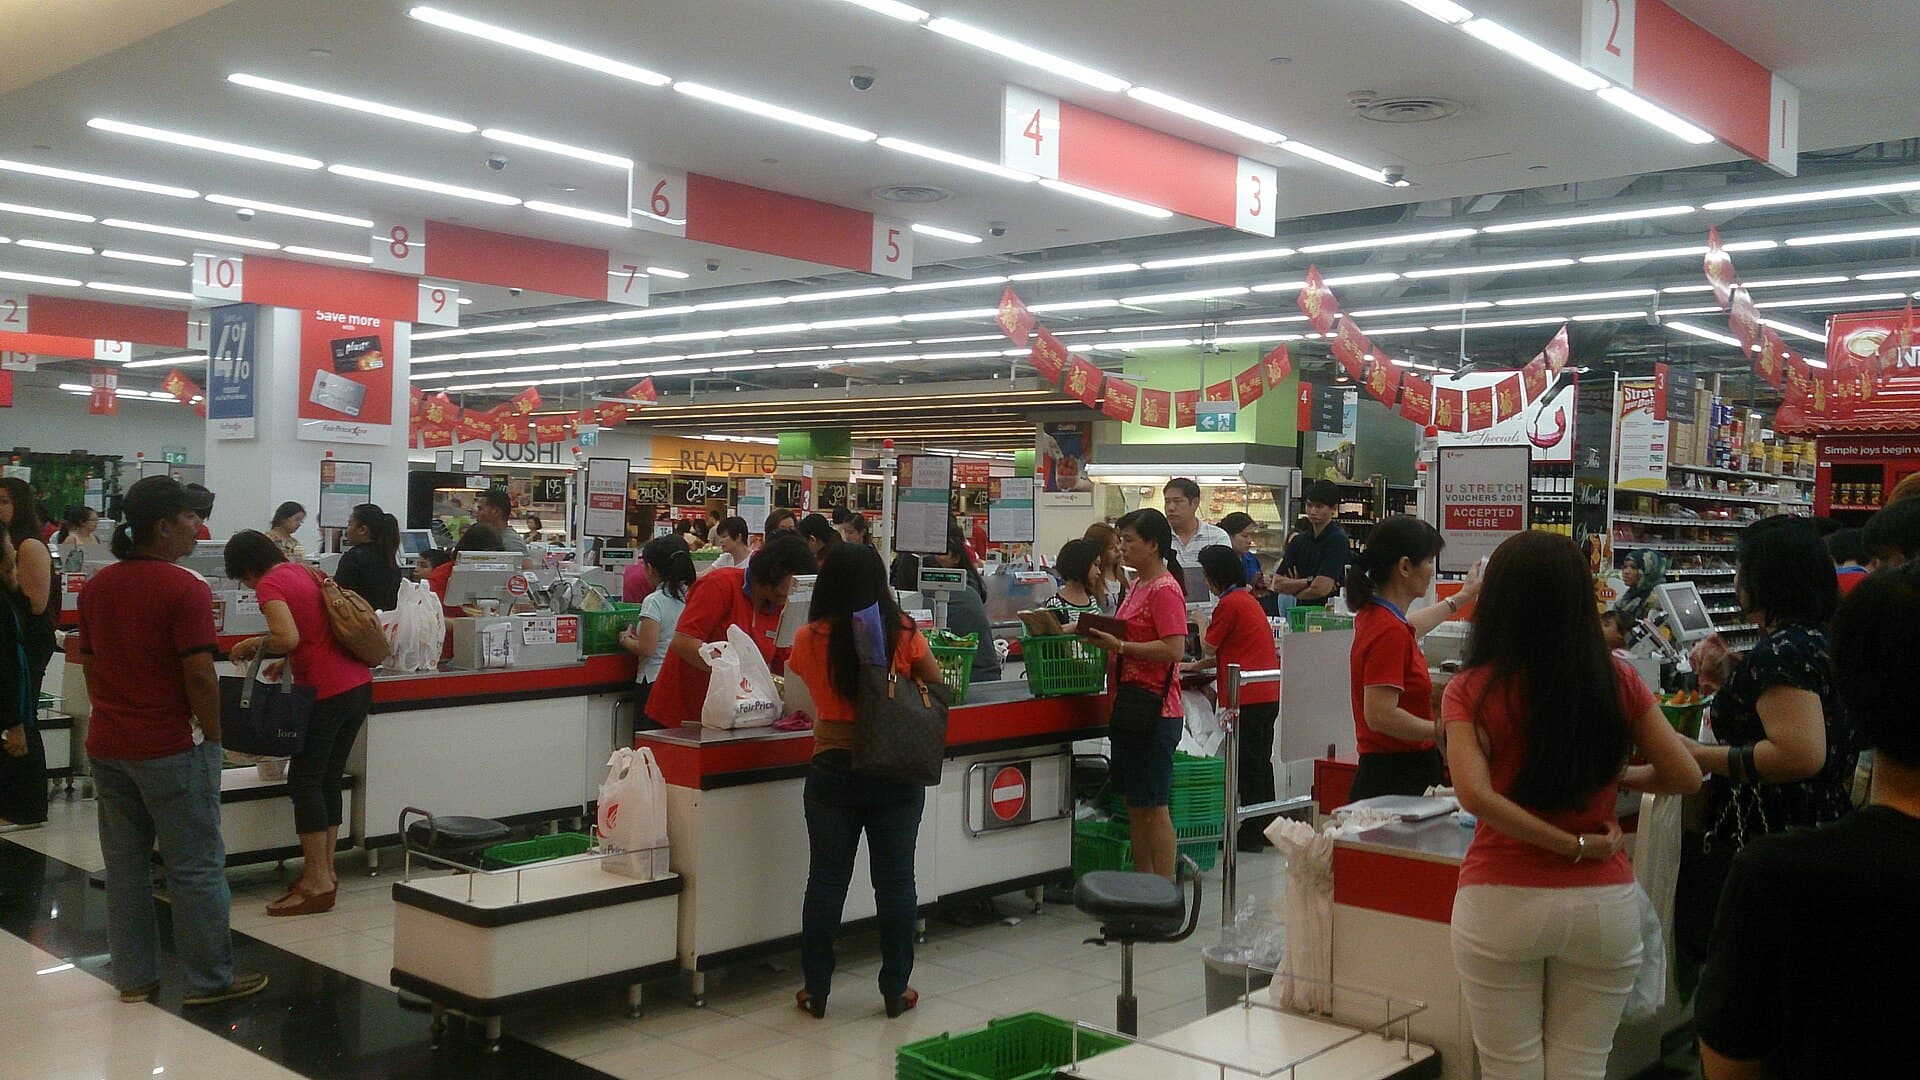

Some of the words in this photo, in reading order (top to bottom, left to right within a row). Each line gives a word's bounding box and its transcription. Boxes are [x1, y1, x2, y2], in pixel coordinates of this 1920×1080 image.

[1022, 108, 1044, 156] 4
[1781, 99, 1787, 149] 1
[650, 181, 671, 217] 6
[1249, 175, 1262, 216] 3
[389, 225, 410, 259] 8
[886, 229, 901, 263] 5
[205, 256, 235, 289] 10
[622, 264, 638, 294] 7
[431, 288, 446, 314] 9
[316, 309, 347, 323] Save
[349, 314, 381, 328] more
[1068, 365, 1090, 397] 福
[1658, 372, 1665, 390] 3
[1144, 397, 1160, 423] 福
[1301, 389, 1308, 405] 4
[1470, 427, 1521, 446] Specials
[492, 438, 561, 465] SUSHI
[680, 449, 747, 473] READY
[748, 453, 778, 474] TO
[1824, 445, 1859, 457] Simple
[1860, 445, 1881, 457] joys
[1882, 444, 1912, 457] begin
[1444, 484, 1453, 493] U
[1460, 483, 1524, 494] STRETCH
[1445, 494, 1498, 502] VOUCHERS
[1501, 494, 1523, 502] 2013
[1453, 508, 1515, 518] ACCEPTED
[1468, 518, 1499, 528] HERE
